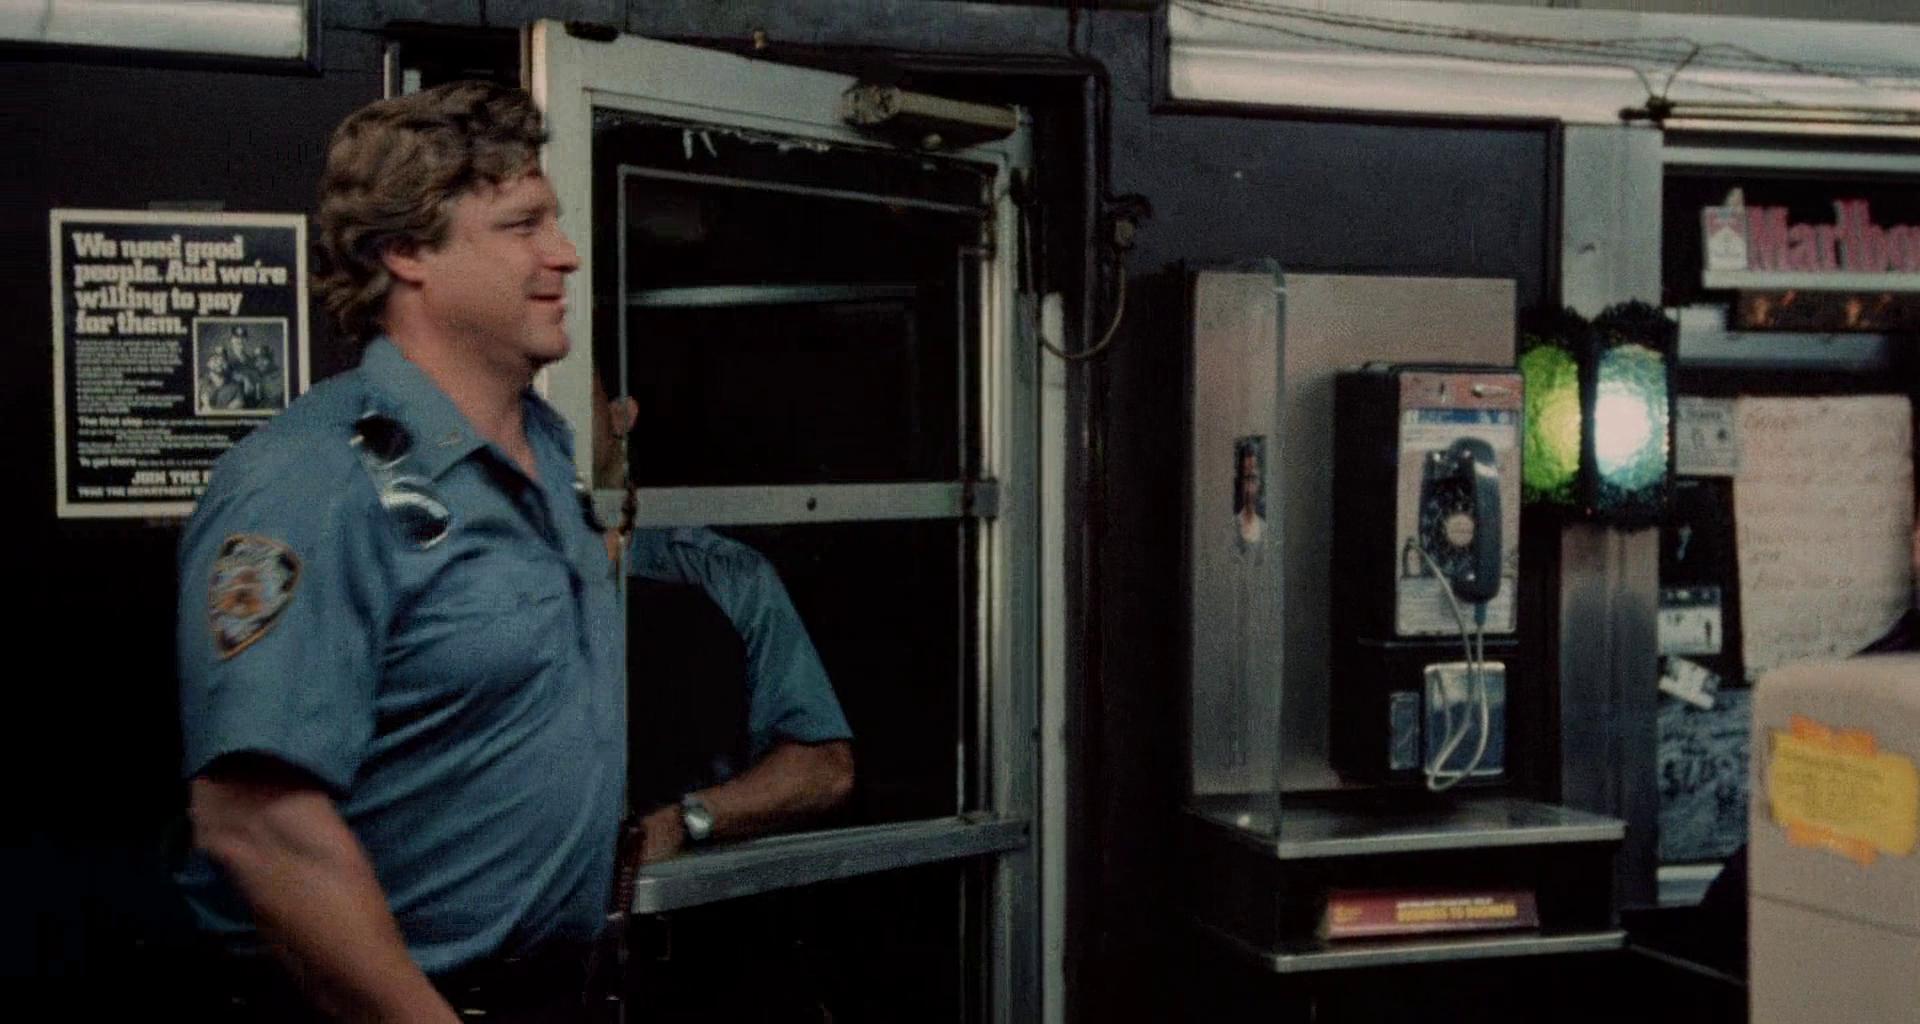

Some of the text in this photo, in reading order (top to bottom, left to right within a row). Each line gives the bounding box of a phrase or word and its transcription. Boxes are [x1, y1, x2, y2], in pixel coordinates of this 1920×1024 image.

[72, 232, 244, 264] We need good
[73, 258, 287, 288] people. And we're
[74, 283, 243, 316] willing to pay
[76, 309, 188, 334] for them.
[78, 415, 98, 427] The
[99, 415, 120, 427] first
[92, 457, 109, 469] get
[110, 457, 137, 467] there
[131, 470, 166, 485] JOIN
[168, 470, 201, 485] THE
